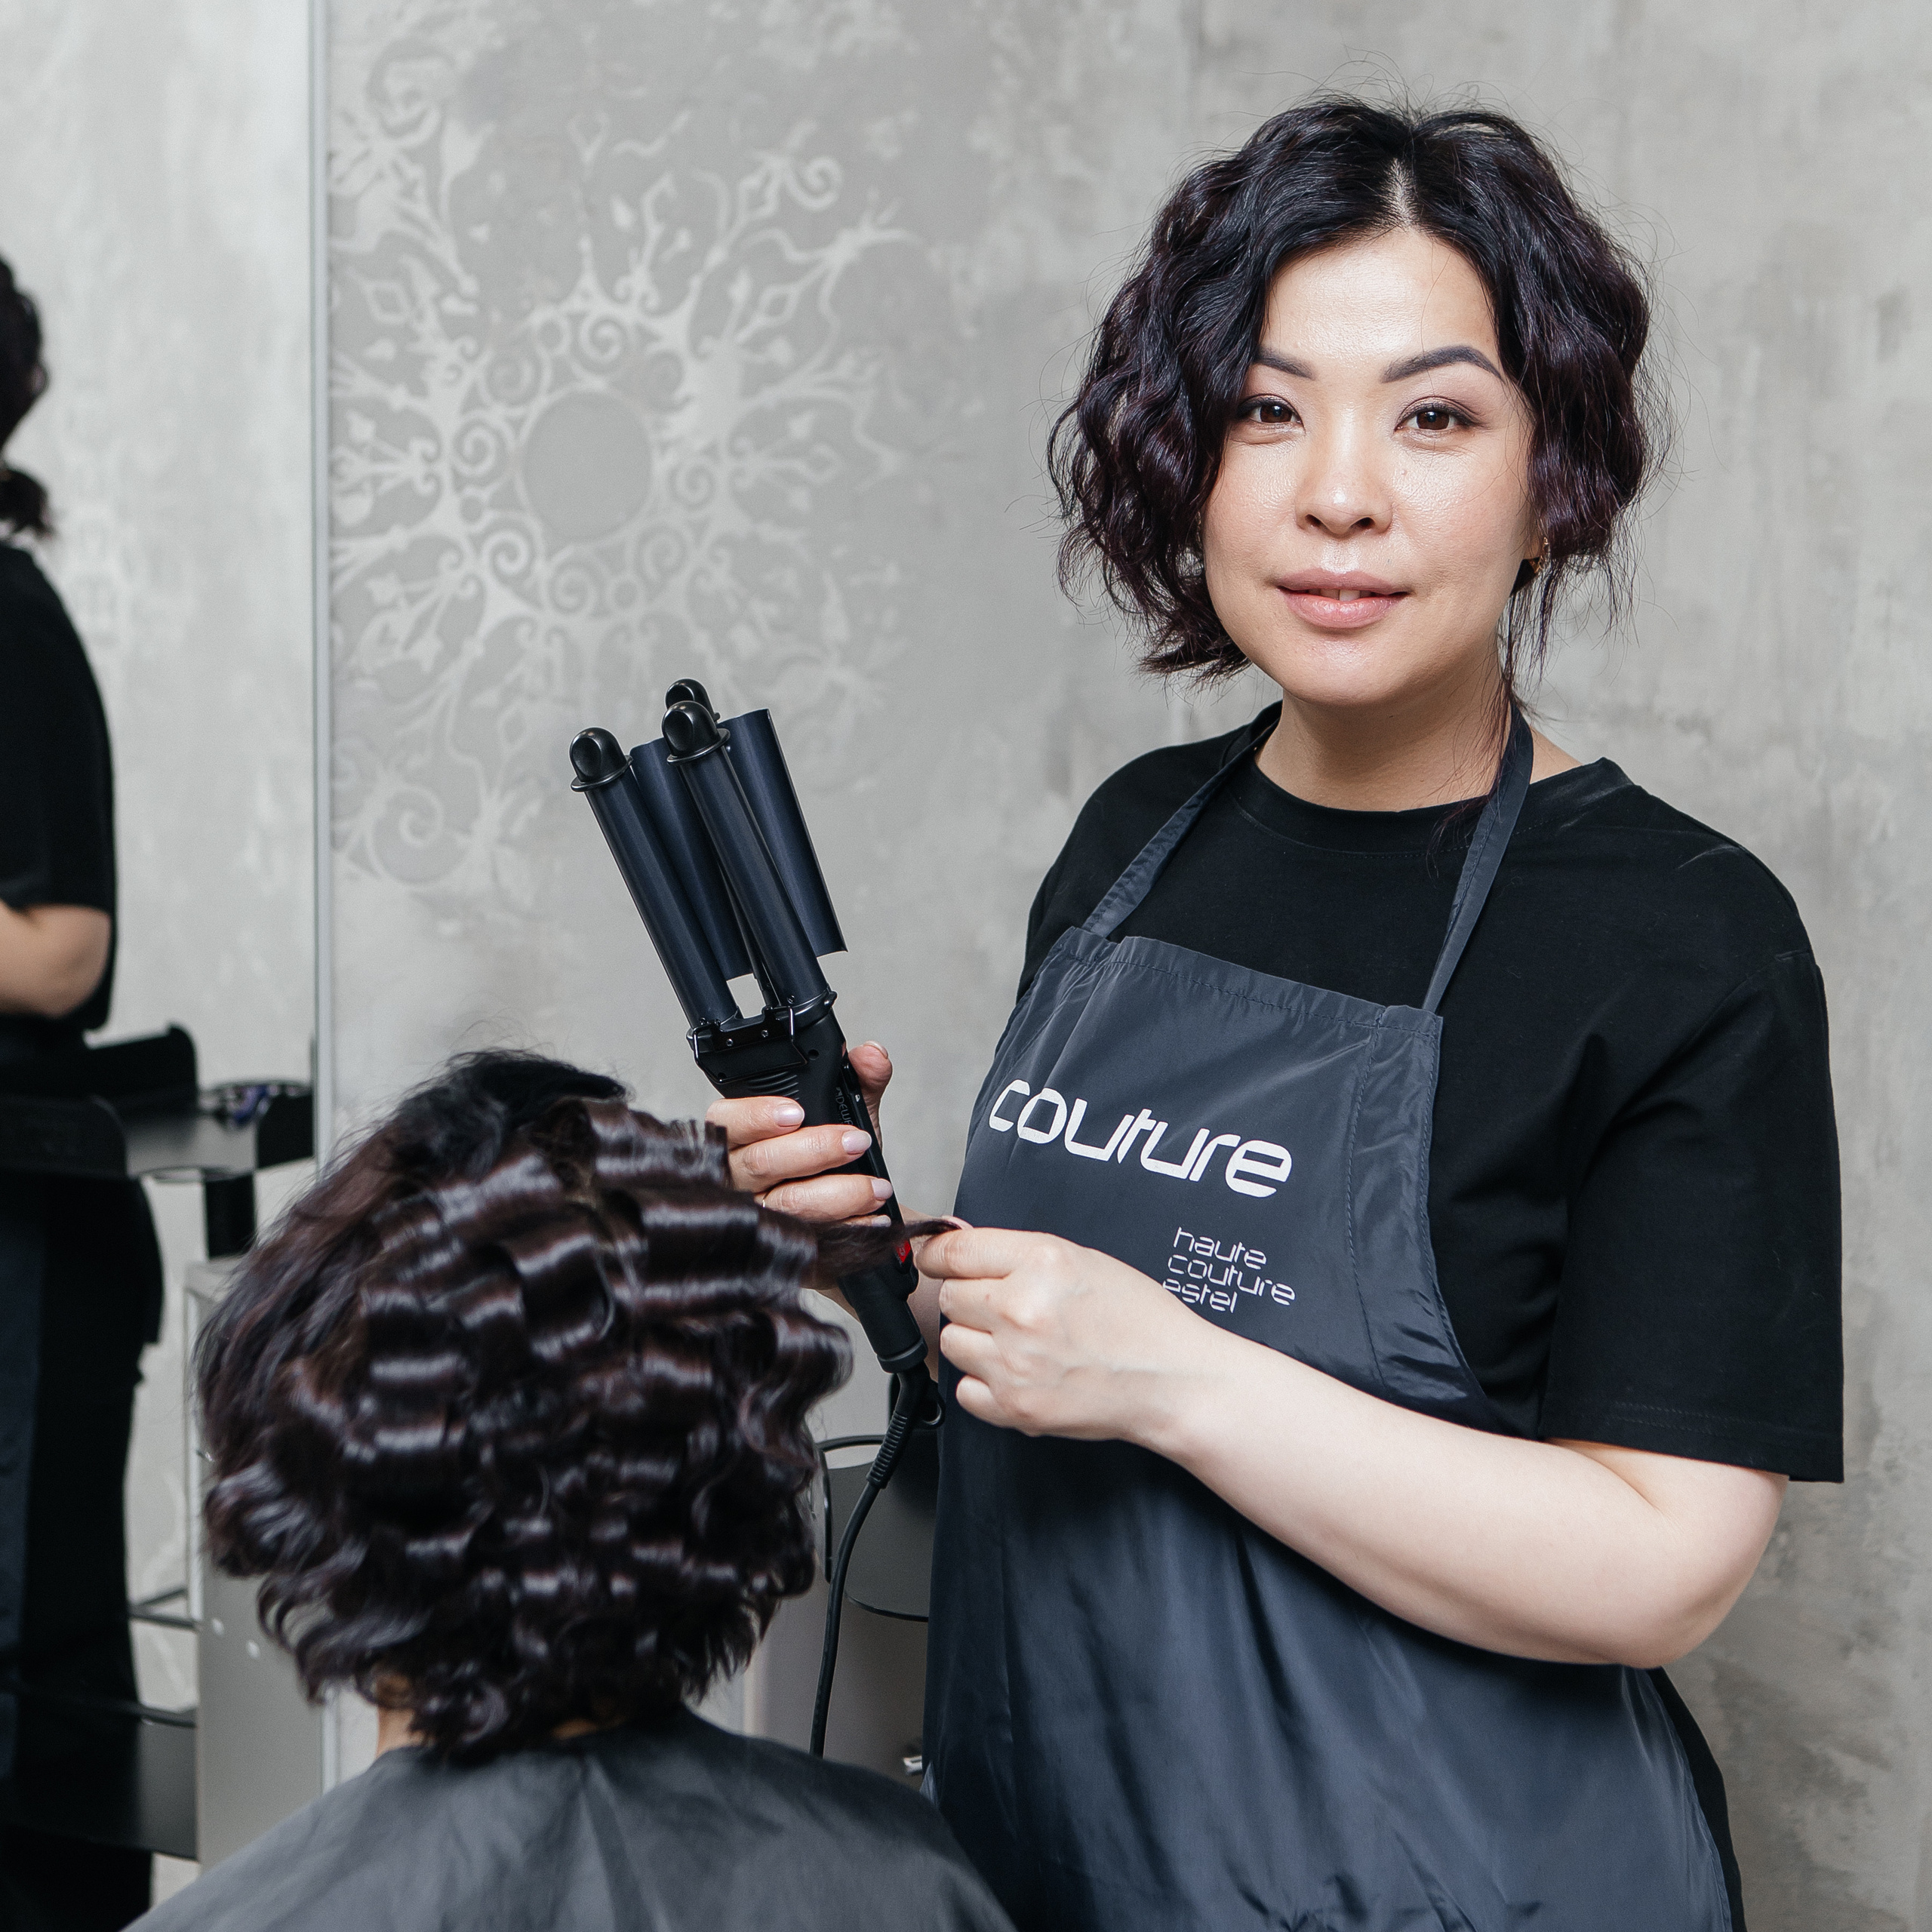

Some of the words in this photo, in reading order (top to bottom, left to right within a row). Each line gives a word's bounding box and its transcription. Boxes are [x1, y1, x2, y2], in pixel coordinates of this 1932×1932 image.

[989, 1079, 1292, 1198] couture
[1174, 1226, 1267, 1270] haute
[1168, 1254, 1297, 1306] couture
